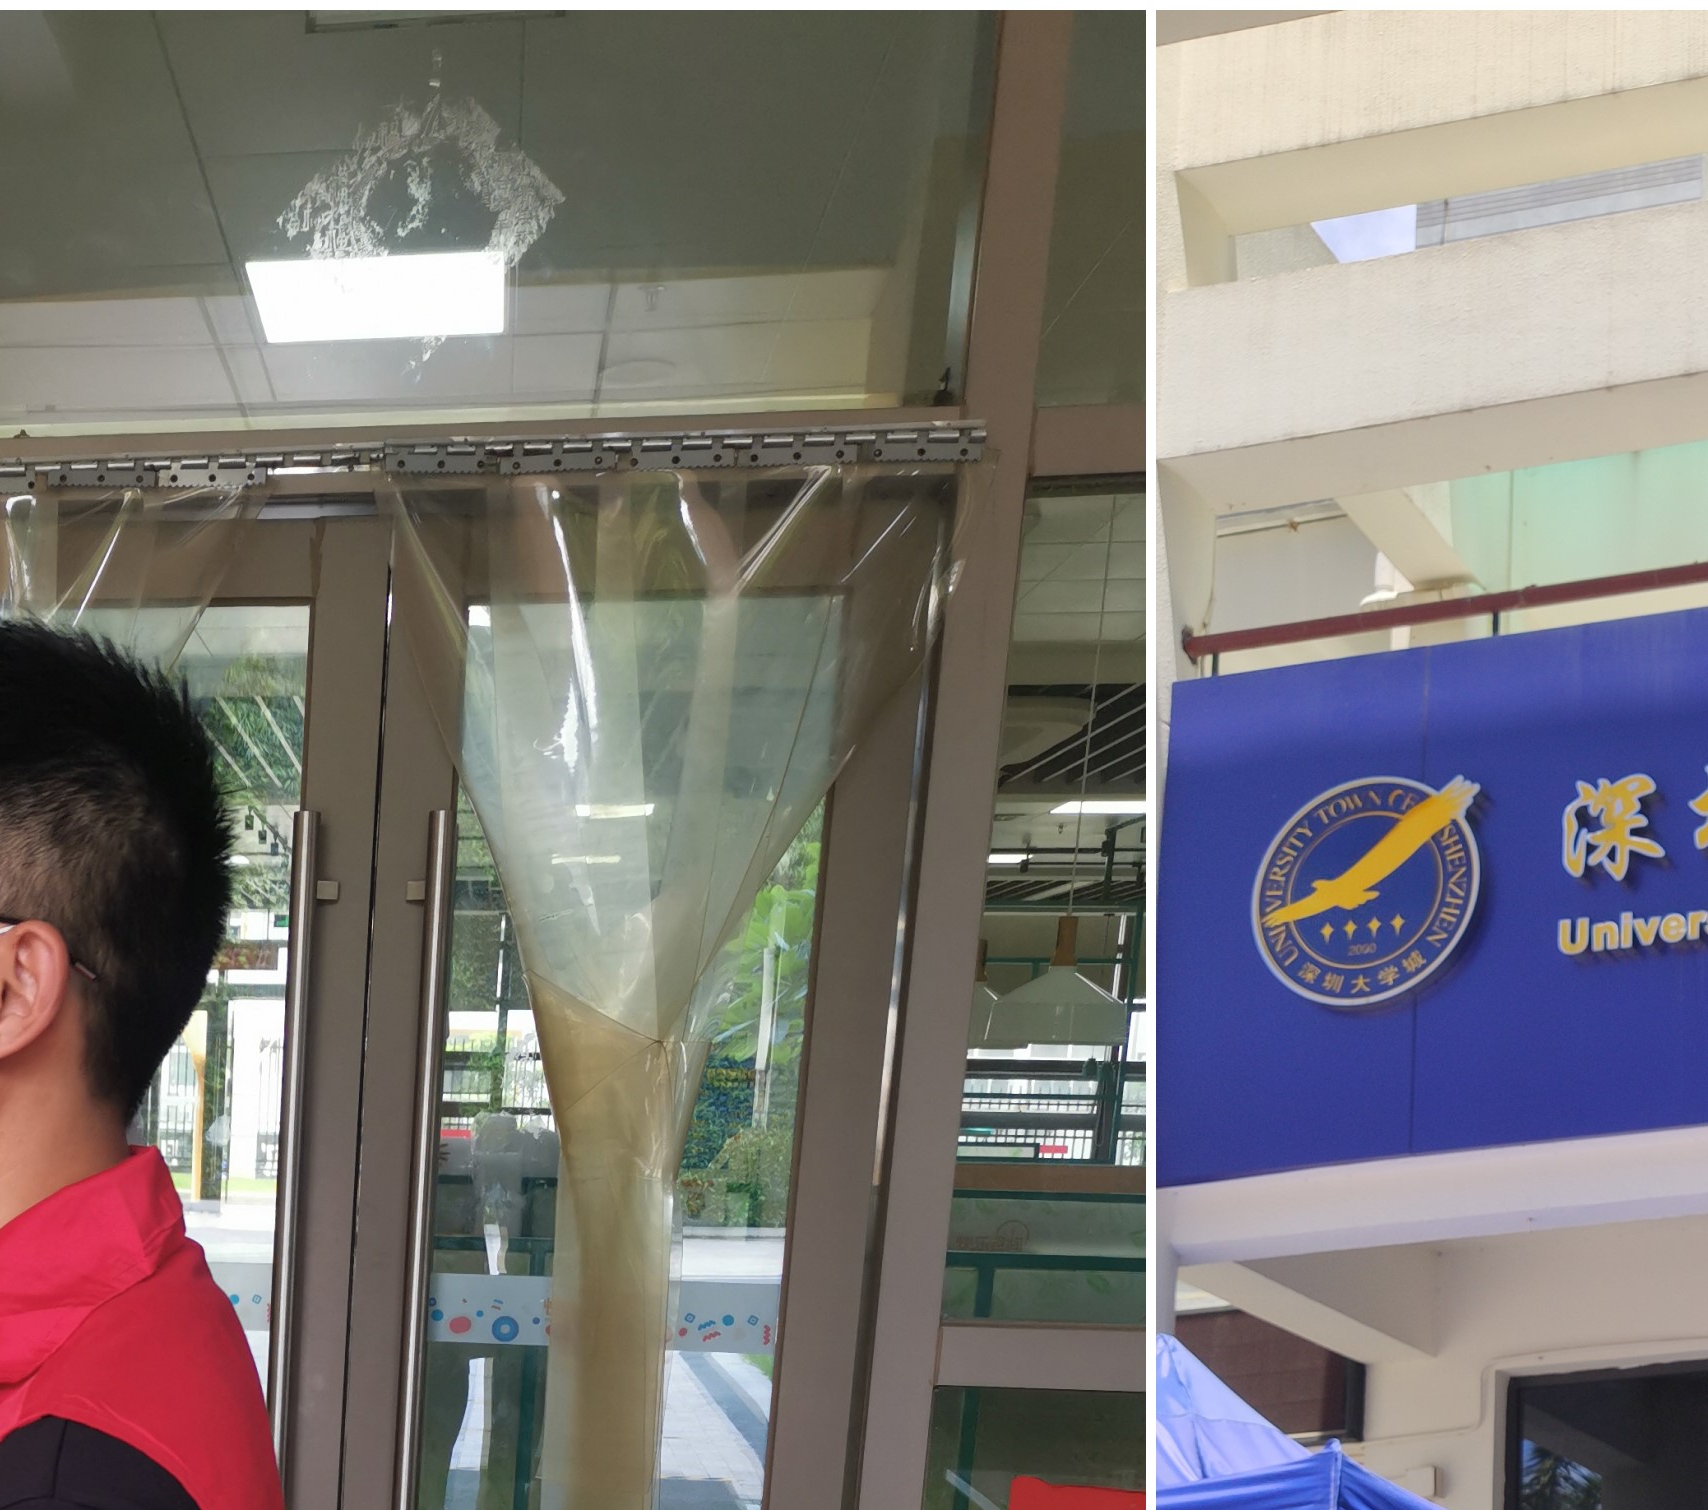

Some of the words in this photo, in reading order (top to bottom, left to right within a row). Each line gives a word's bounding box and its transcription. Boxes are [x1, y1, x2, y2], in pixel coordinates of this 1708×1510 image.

[1426, 825, 1468, 947] SHENZHEN
[1297, 949, 1427, 995] 深圳大学城
